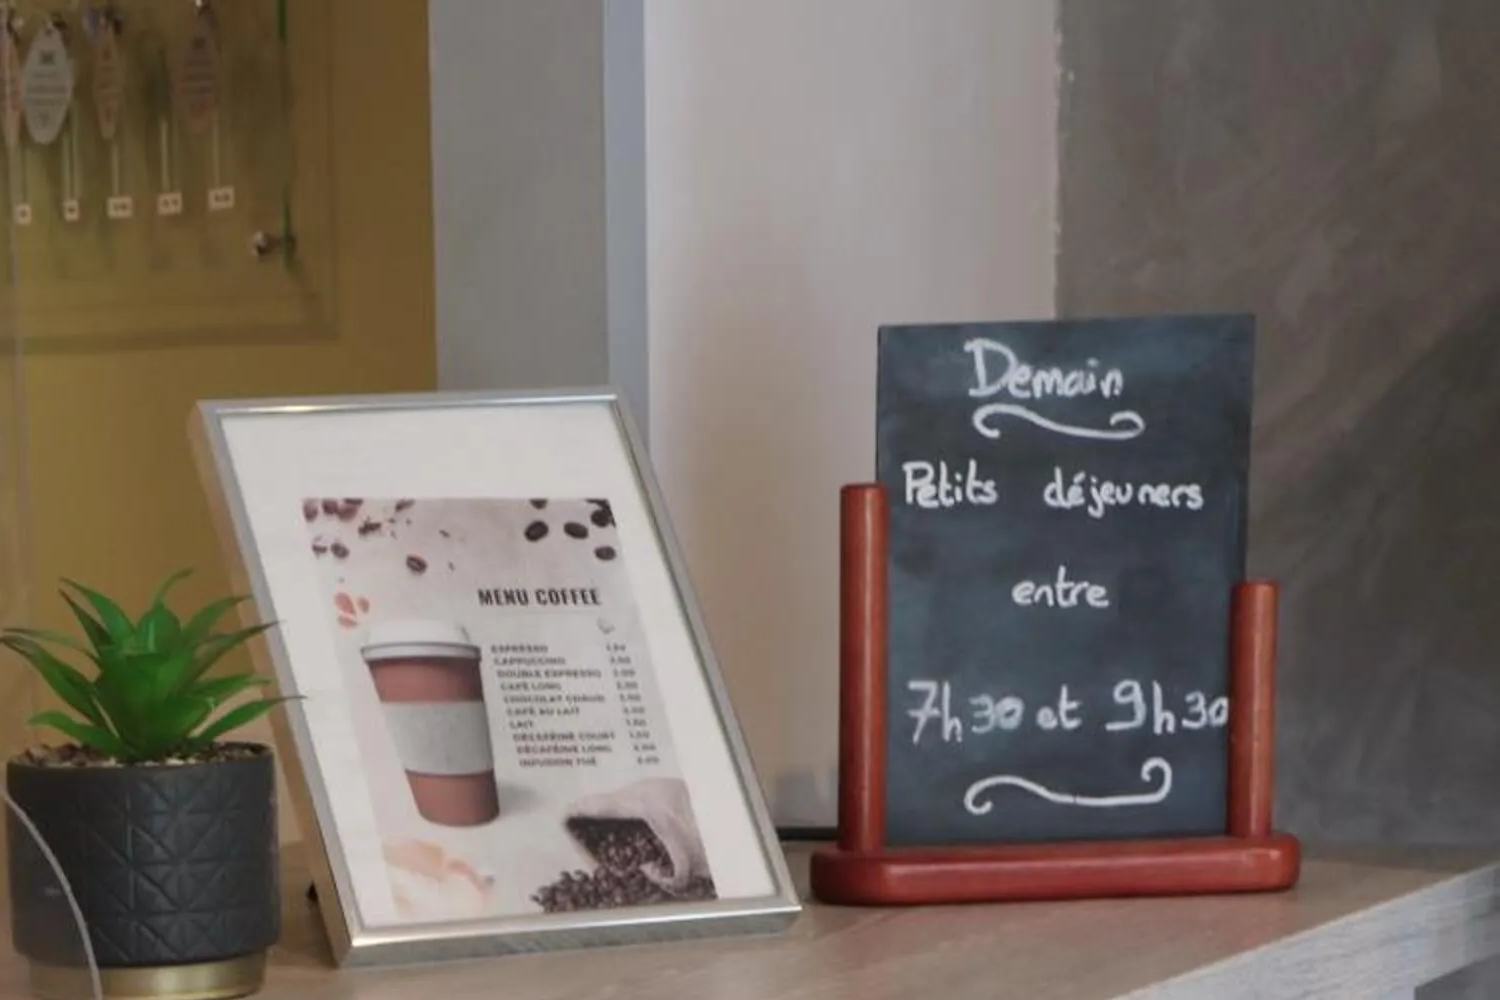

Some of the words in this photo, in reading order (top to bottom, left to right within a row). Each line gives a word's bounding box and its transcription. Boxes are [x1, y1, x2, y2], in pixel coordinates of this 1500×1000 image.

[964, 337, 1124, 399] Demain
[902, 458, 999, 508] Petits
[1044, 466, 1204, 519] déjeuners
[478, 588, 529, 606] MENU
[535, 588, 602, 606] COFFEE
[1011, 565, 1109, 608] entre
[907, 680, 1024, 745] 7h30
[1036, 684, 1083, 730] et
[1105, 679, 1229, 735] 9h30
